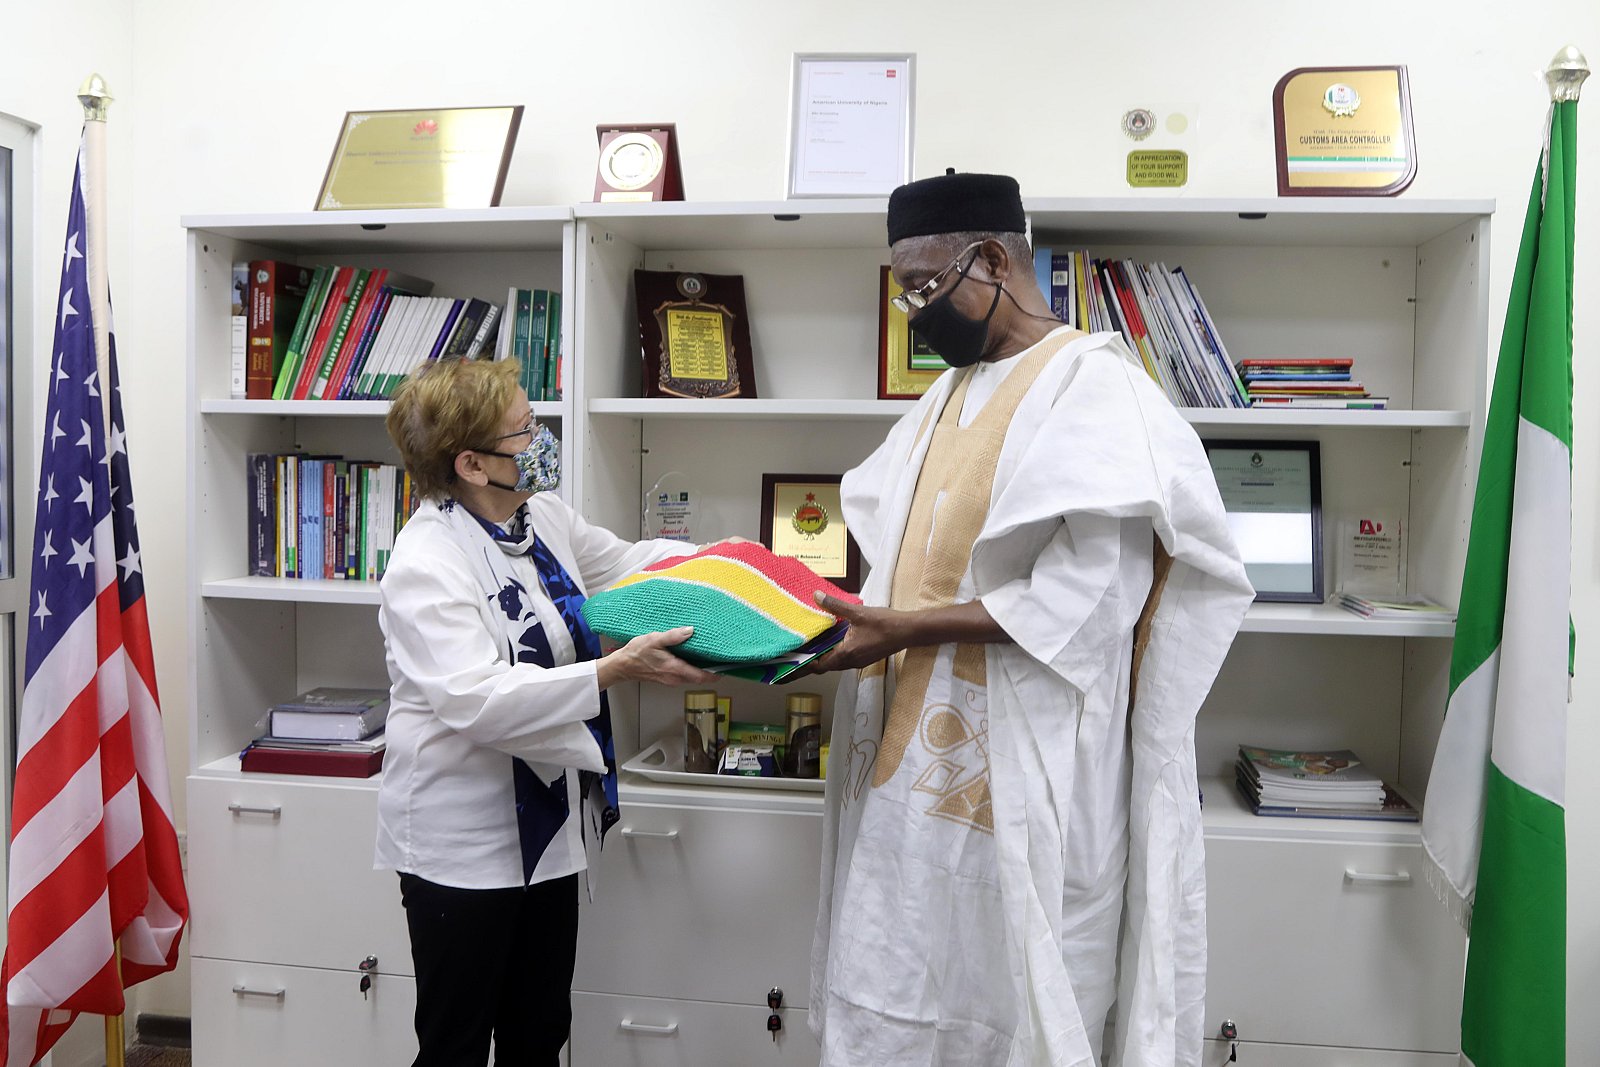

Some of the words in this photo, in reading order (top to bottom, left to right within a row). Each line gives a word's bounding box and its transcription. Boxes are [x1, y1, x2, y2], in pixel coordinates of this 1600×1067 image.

[1300, 136, 1329, 144] CUSTOMS
[1332, 136, 1348, 144] AREA
[1349, 136, 1391, 144] CONTROLLER
[339, 278, 365, 331] MANAGEMENT
[337, 330, 345, 338] &
[321, 337, 342, 377] STRATEGY
